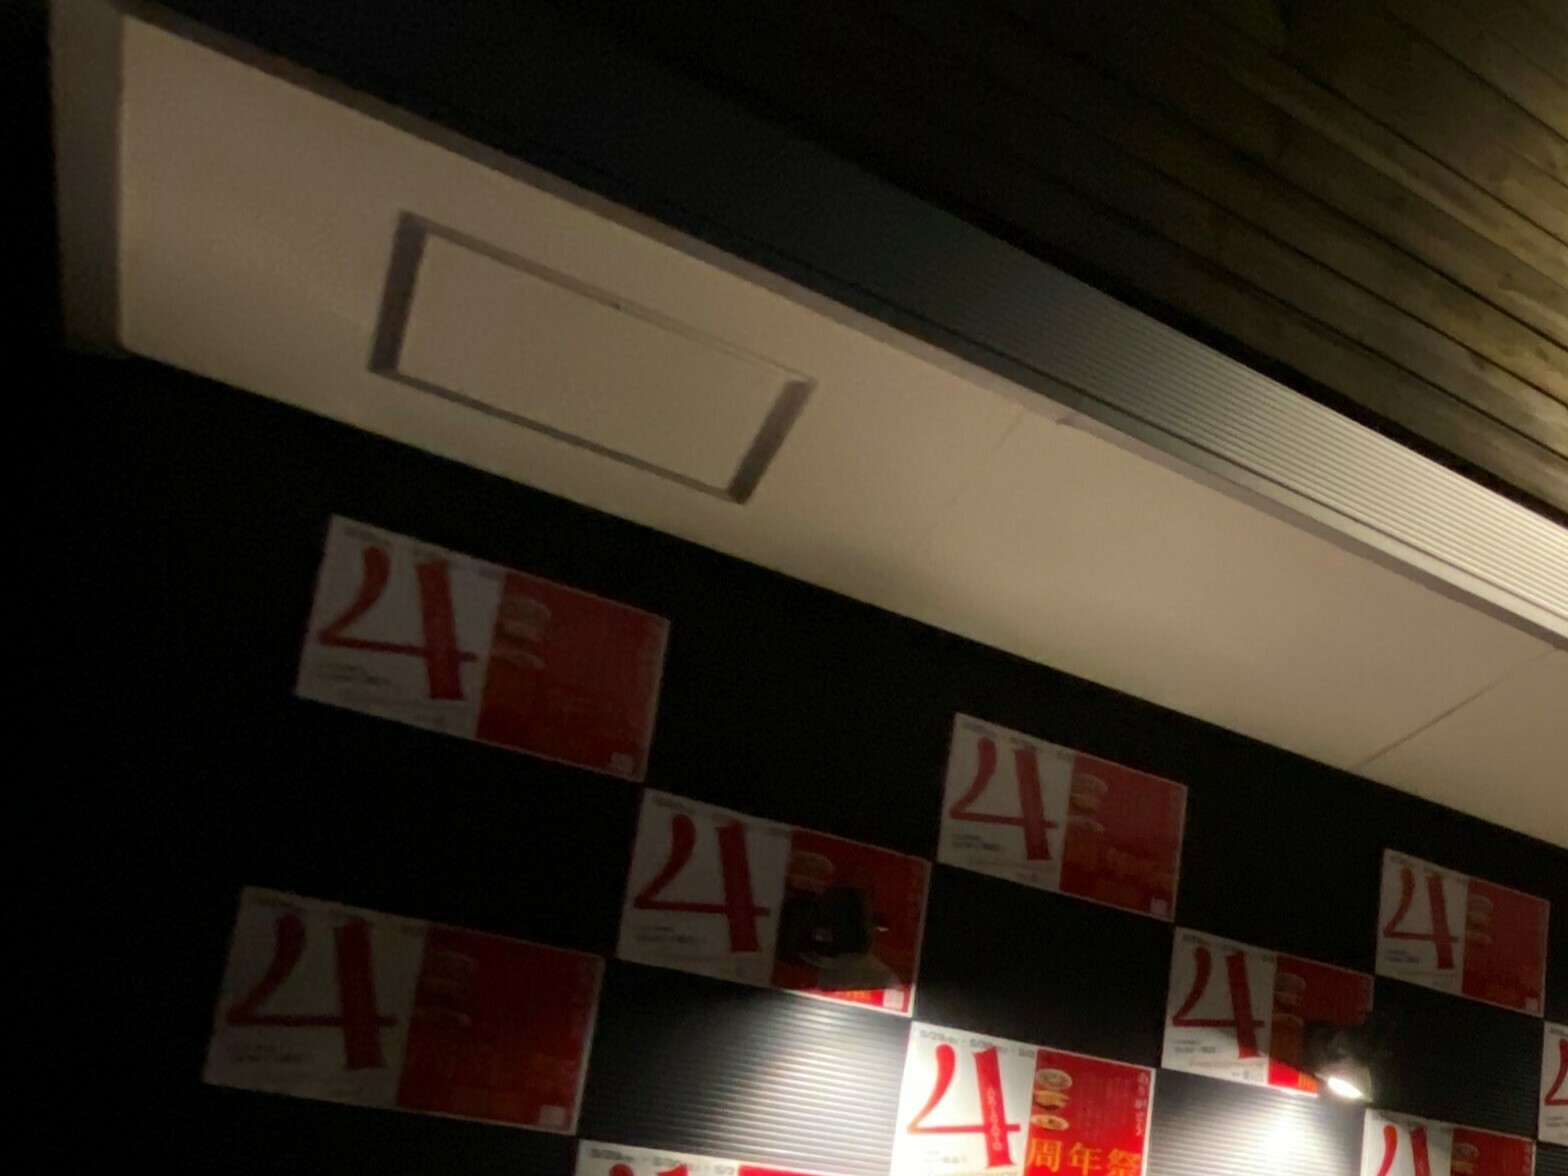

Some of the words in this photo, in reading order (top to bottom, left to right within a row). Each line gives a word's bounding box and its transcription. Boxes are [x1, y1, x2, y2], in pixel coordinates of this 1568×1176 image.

[318, 547, 476, 700] 4
[950, 738, 1055, 863] 4
[634, 815, 767, 952] 4
[1384, 869, 1457, 970] 4
[226, 912, 397, 1070] 4
[1173, 947, 1264, 1058] 4
[906, 1043, 1020, 1169] 4
